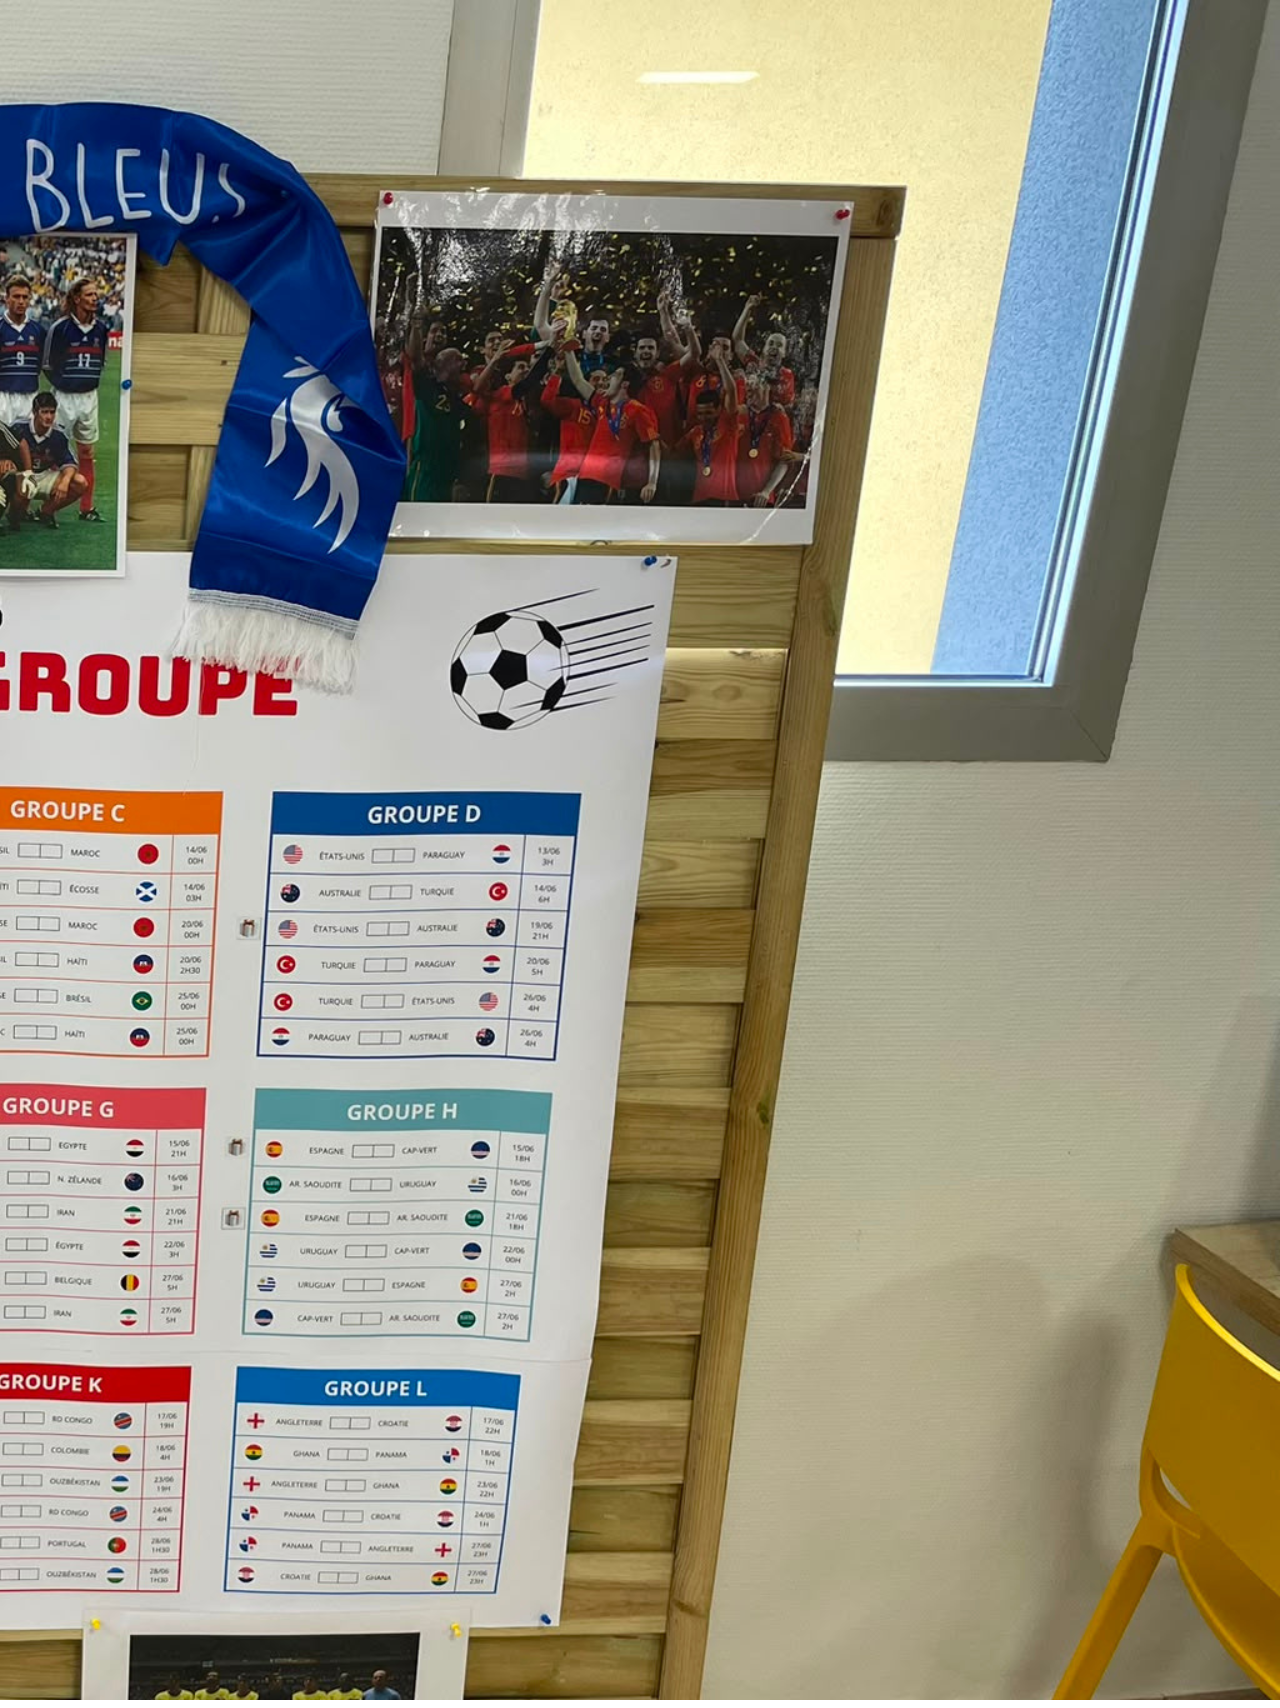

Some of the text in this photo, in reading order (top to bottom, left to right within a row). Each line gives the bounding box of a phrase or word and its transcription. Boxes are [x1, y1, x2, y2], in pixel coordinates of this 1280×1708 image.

[16, 352, 25, 365] 9
[77, 353, 91, 367] 17
[11, 800, 125, 822] GROUPE C
[368, 805, 480, 824] GROUPE D
[71, 849, 100, 857] MAROC
[423, 851, 465, 859] PARAGUAY
[538, 847, 560, 855] 13/06
[188, 857, 204, 865] 00H
[542, 858, 554, 866] 3H
[420, 888, 454, 897] TURQUIE
[186, 894, 201, 902] 03H
[3, 1098, 113, 1117] GROUPE G
[347, 1103, 457, 1120] GROUPE H
[309, 1147, 344, 1155] ESPAGNE
[304, 1181, 342, 1189] SAOUDITE
[510, 1179, 531, 1187] 16/06
[89, 1377, 102, 1393] K
[325, 1381, 427, 1396] GROUPE L
[64, 1416, 93, 1424] CONGO
[51, 1447, 90, 1455] COLOMBIE
